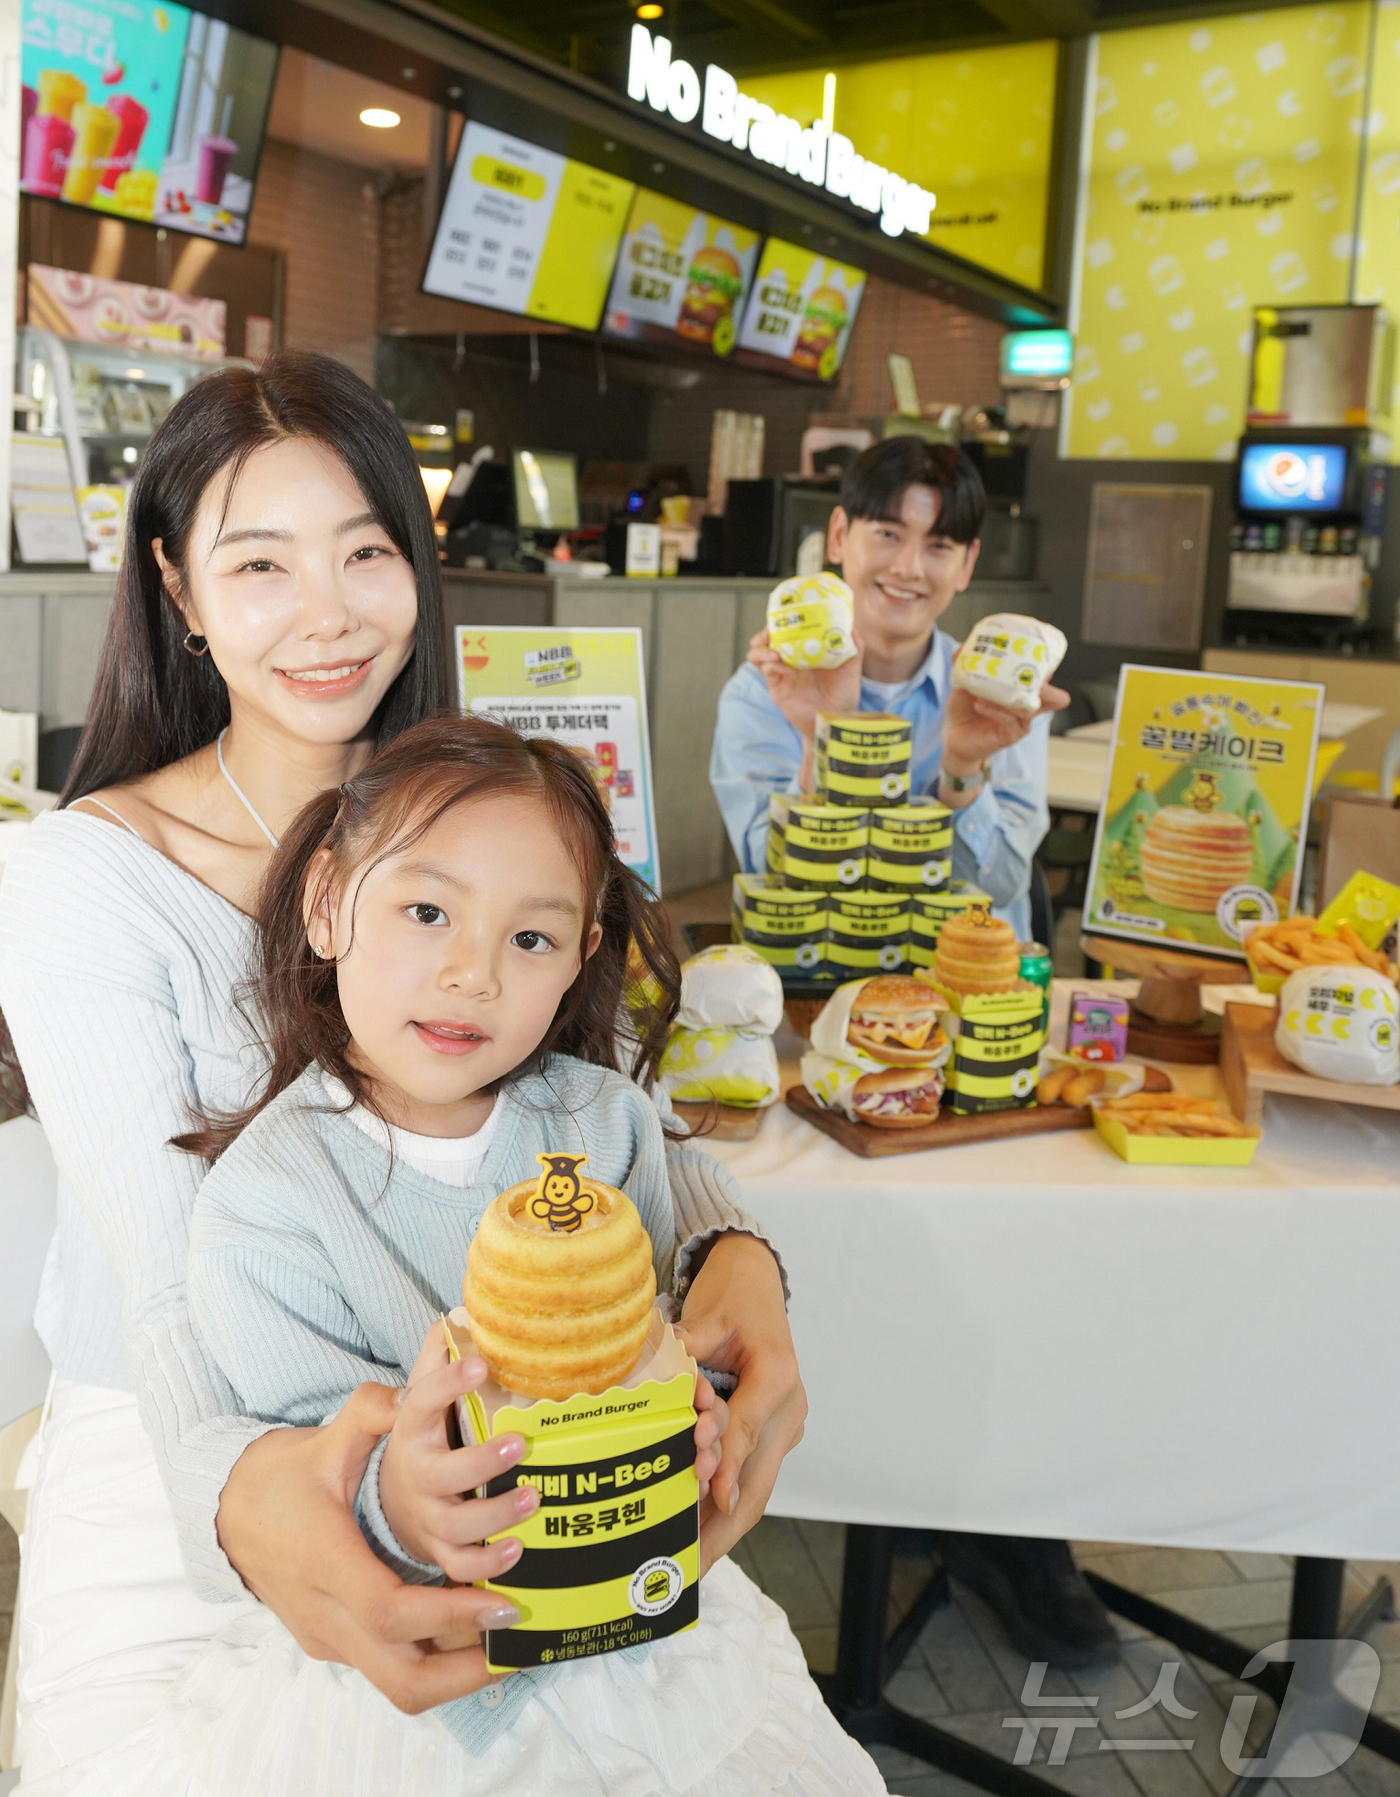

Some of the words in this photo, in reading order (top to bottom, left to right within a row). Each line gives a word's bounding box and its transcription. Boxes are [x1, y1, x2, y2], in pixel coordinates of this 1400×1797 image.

[627, 22, 700, 123] No
[702, 63, 836, 187] Brand
[825, 131, 936, 237] Burger
[540, 1417, 560, 1427] No
[562, 1407, 603, 1423] Brand
[604, 1399, 650, 1415] Burger
[576, 1454, 671, 1495] N-Bee
[544, 1498, 646, 1537] 바움쿠헨
[562, 1631, 579, 1644] 160
[610, 1618, 633, 1634] kcal)
